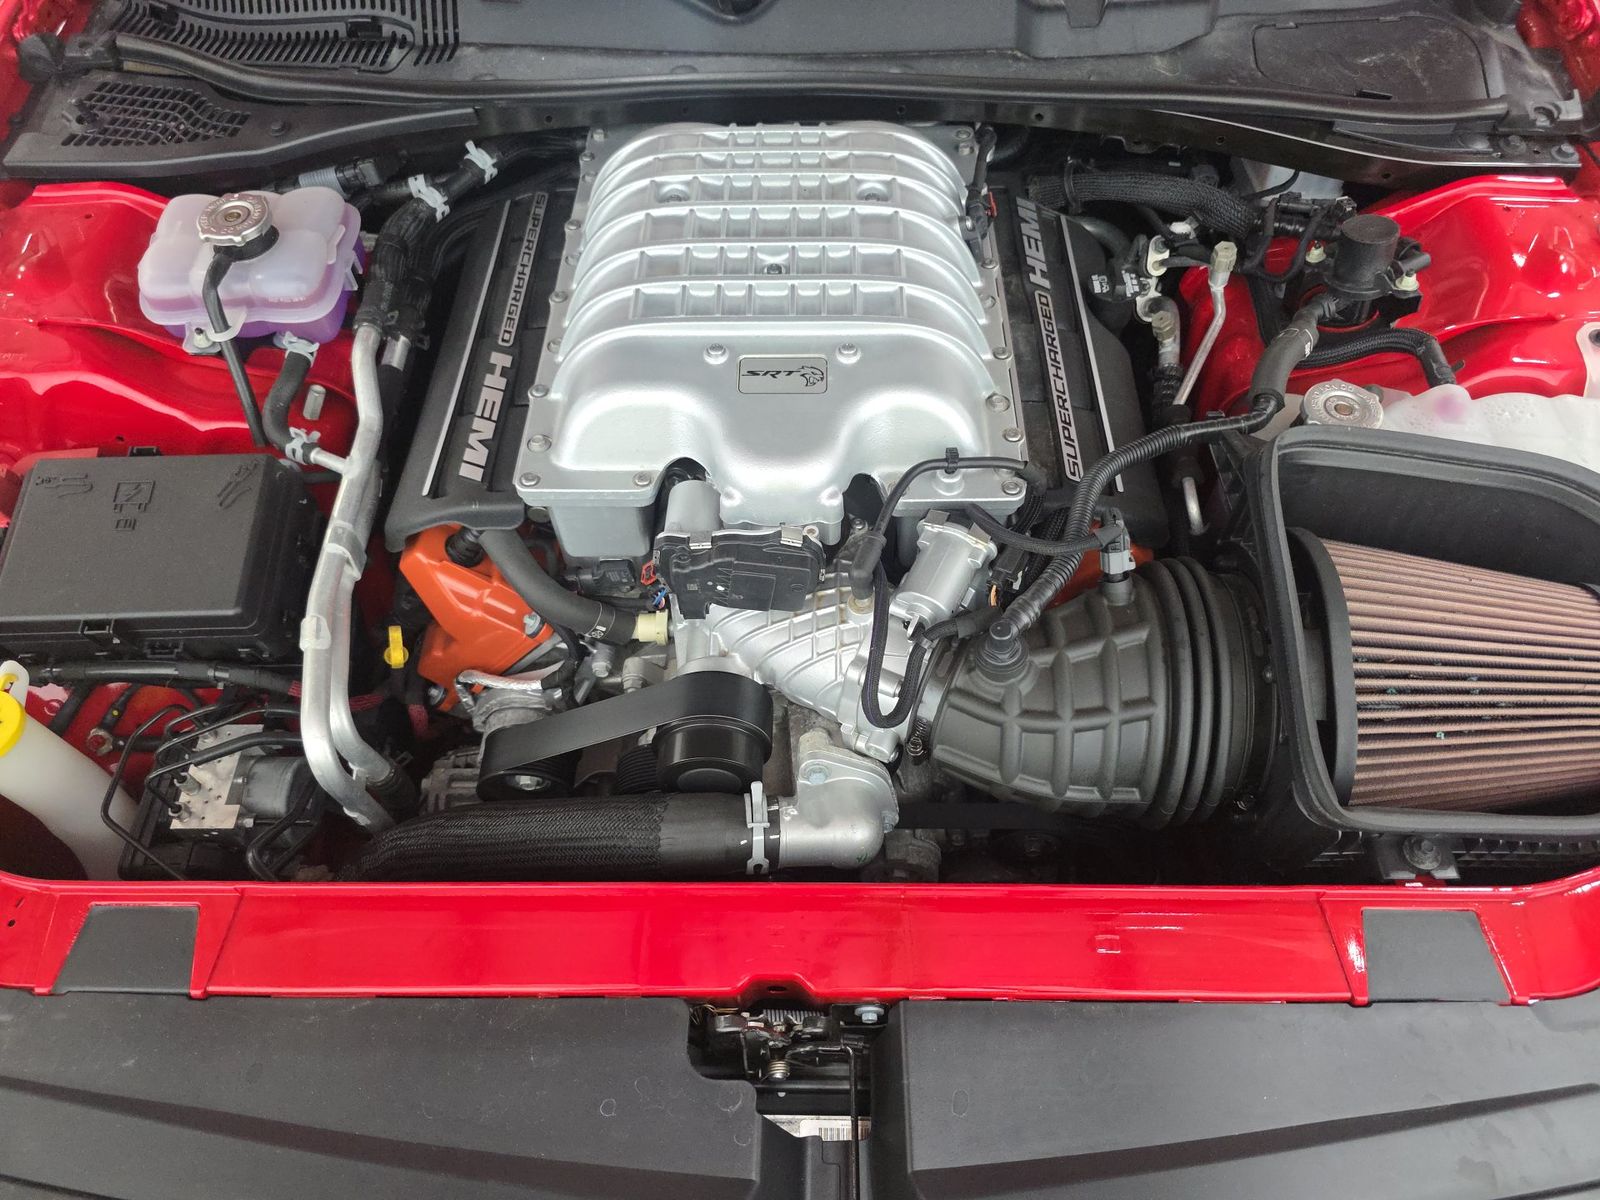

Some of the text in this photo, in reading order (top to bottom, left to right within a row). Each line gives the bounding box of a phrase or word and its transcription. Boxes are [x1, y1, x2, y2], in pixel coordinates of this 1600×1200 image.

[500, 192, 548, 345] SUPERCHARGED
[1017, 197, 1051, 290] HEMI
[459, 352, 513, 482] HEMI
[741, 370, 801, 379] SRT
[1037, 292, 1083, 481] SUPERCHARGED
